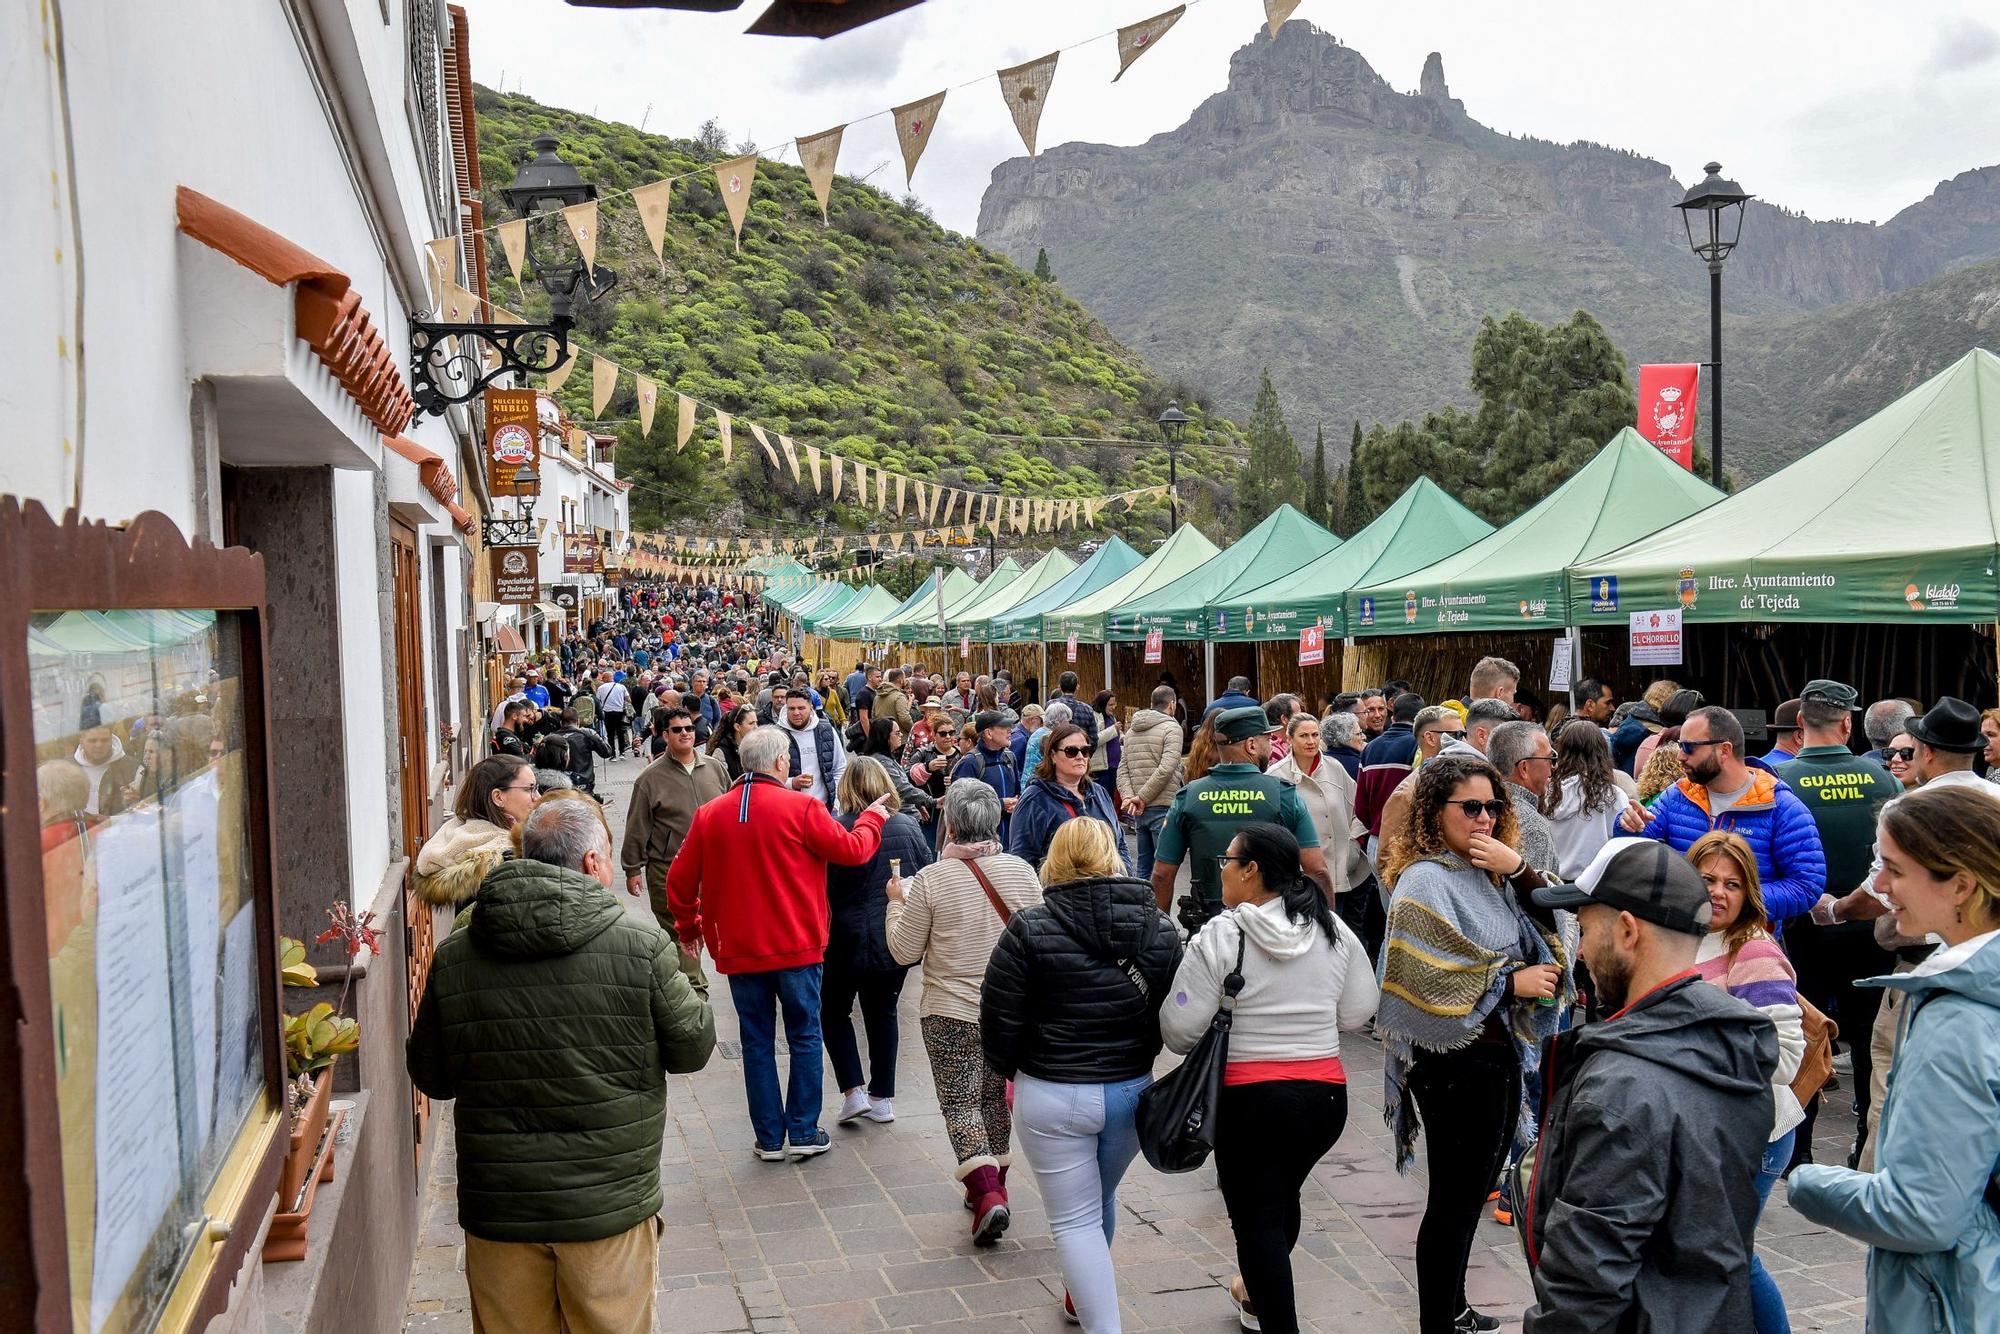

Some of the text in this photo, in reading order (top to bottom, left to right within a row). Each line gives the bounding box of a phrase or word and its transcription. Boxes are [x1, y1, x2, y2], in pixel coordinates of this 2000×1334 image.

[497, 577, 535, 586] Especialidad
[1708, 572, 1836, 591] Iltre. Ayuntamiento
[1439, 593, 1487, 609] Ayuntamiento
[1740, 594, 1800, 612] de Tejeda
[1437, 610, 1469, 625] de Tejeda
[1632, 633, 1680, 644] EL CHORRILLO
[1800, 773, 1875, 788] GUARDIA
[1198, 790, 1266, 801] GUARDIA
[1819, 787, 1865, 801] CIVIL
[1212, 802, 1253, 814] CIVIL
